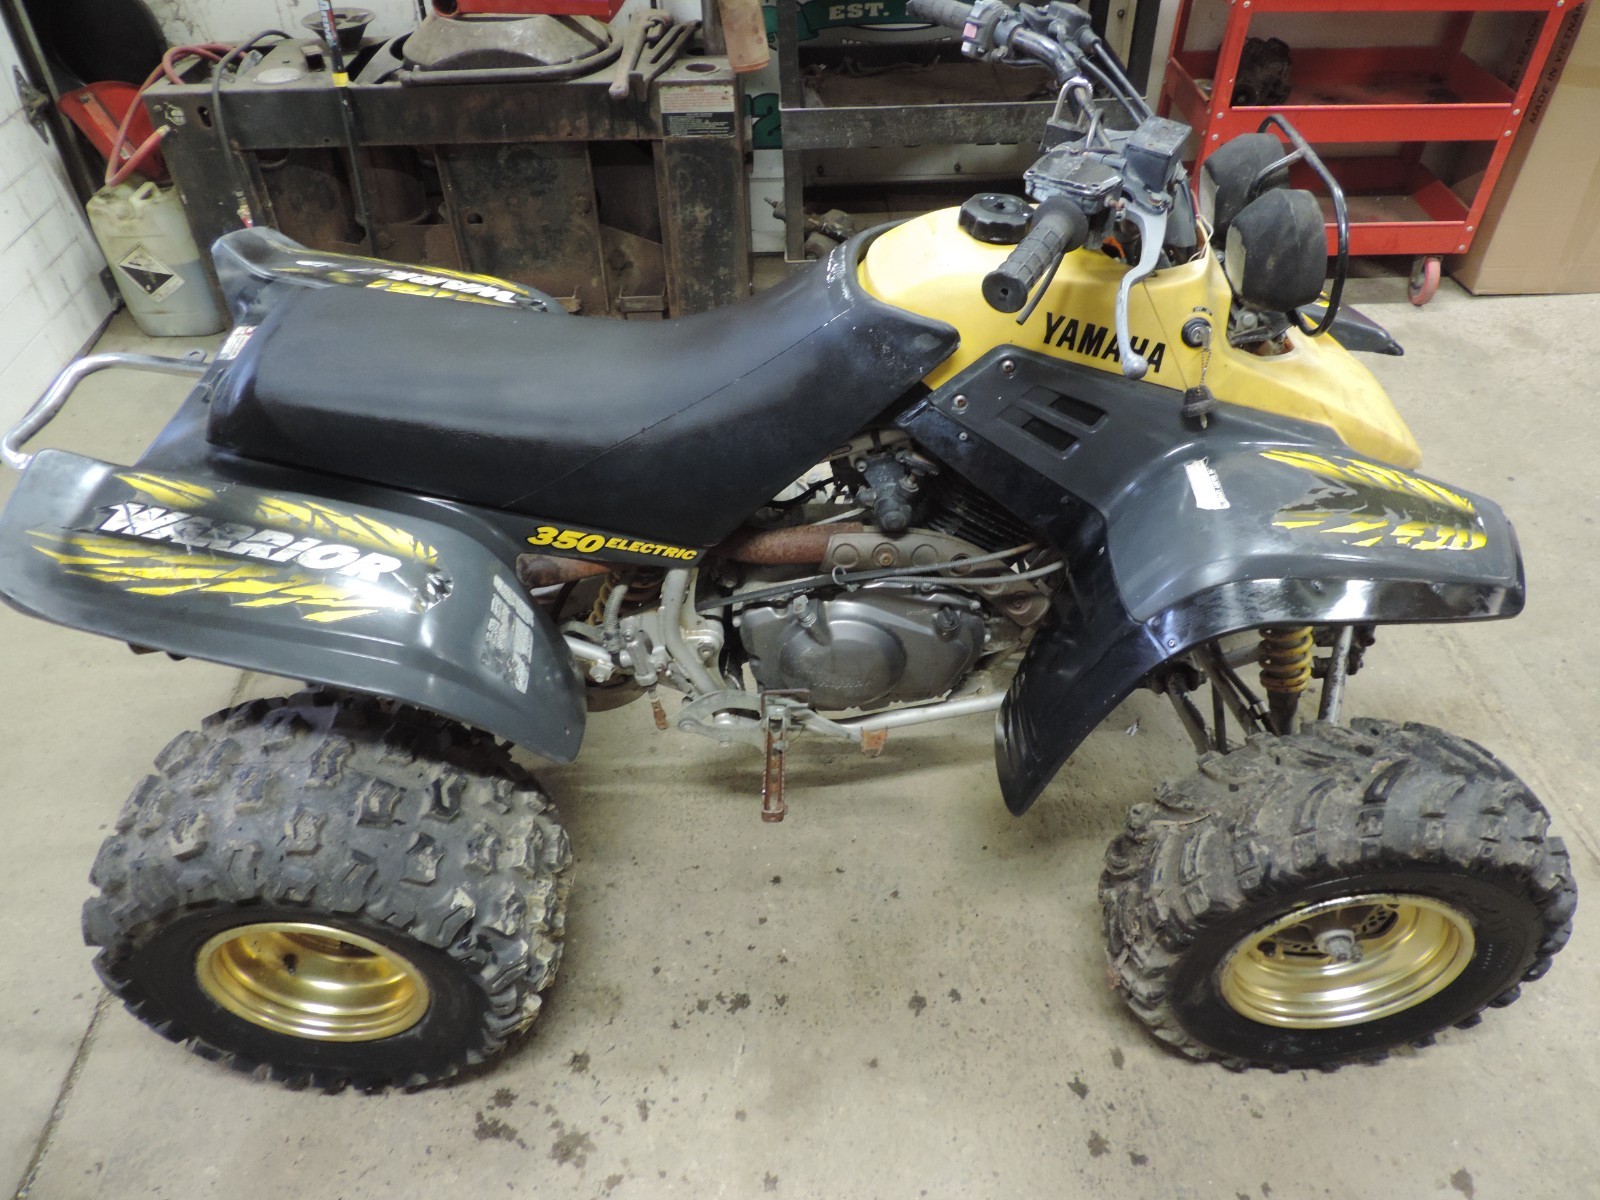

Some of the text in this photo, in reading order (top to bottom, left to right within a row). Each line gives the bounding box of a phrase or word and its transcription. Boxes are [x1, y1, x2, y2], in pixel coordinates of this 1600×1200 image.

[828, 2, 890, 21] EST.
[1529, 1, 1585, 124] MADE IN VIETNAM
[1043, 312, 1166, 373] YAMAHA
[100, 502, 403, 581] WARRIOR
[527, 526, 698, 561] 350 ELECTRIC
